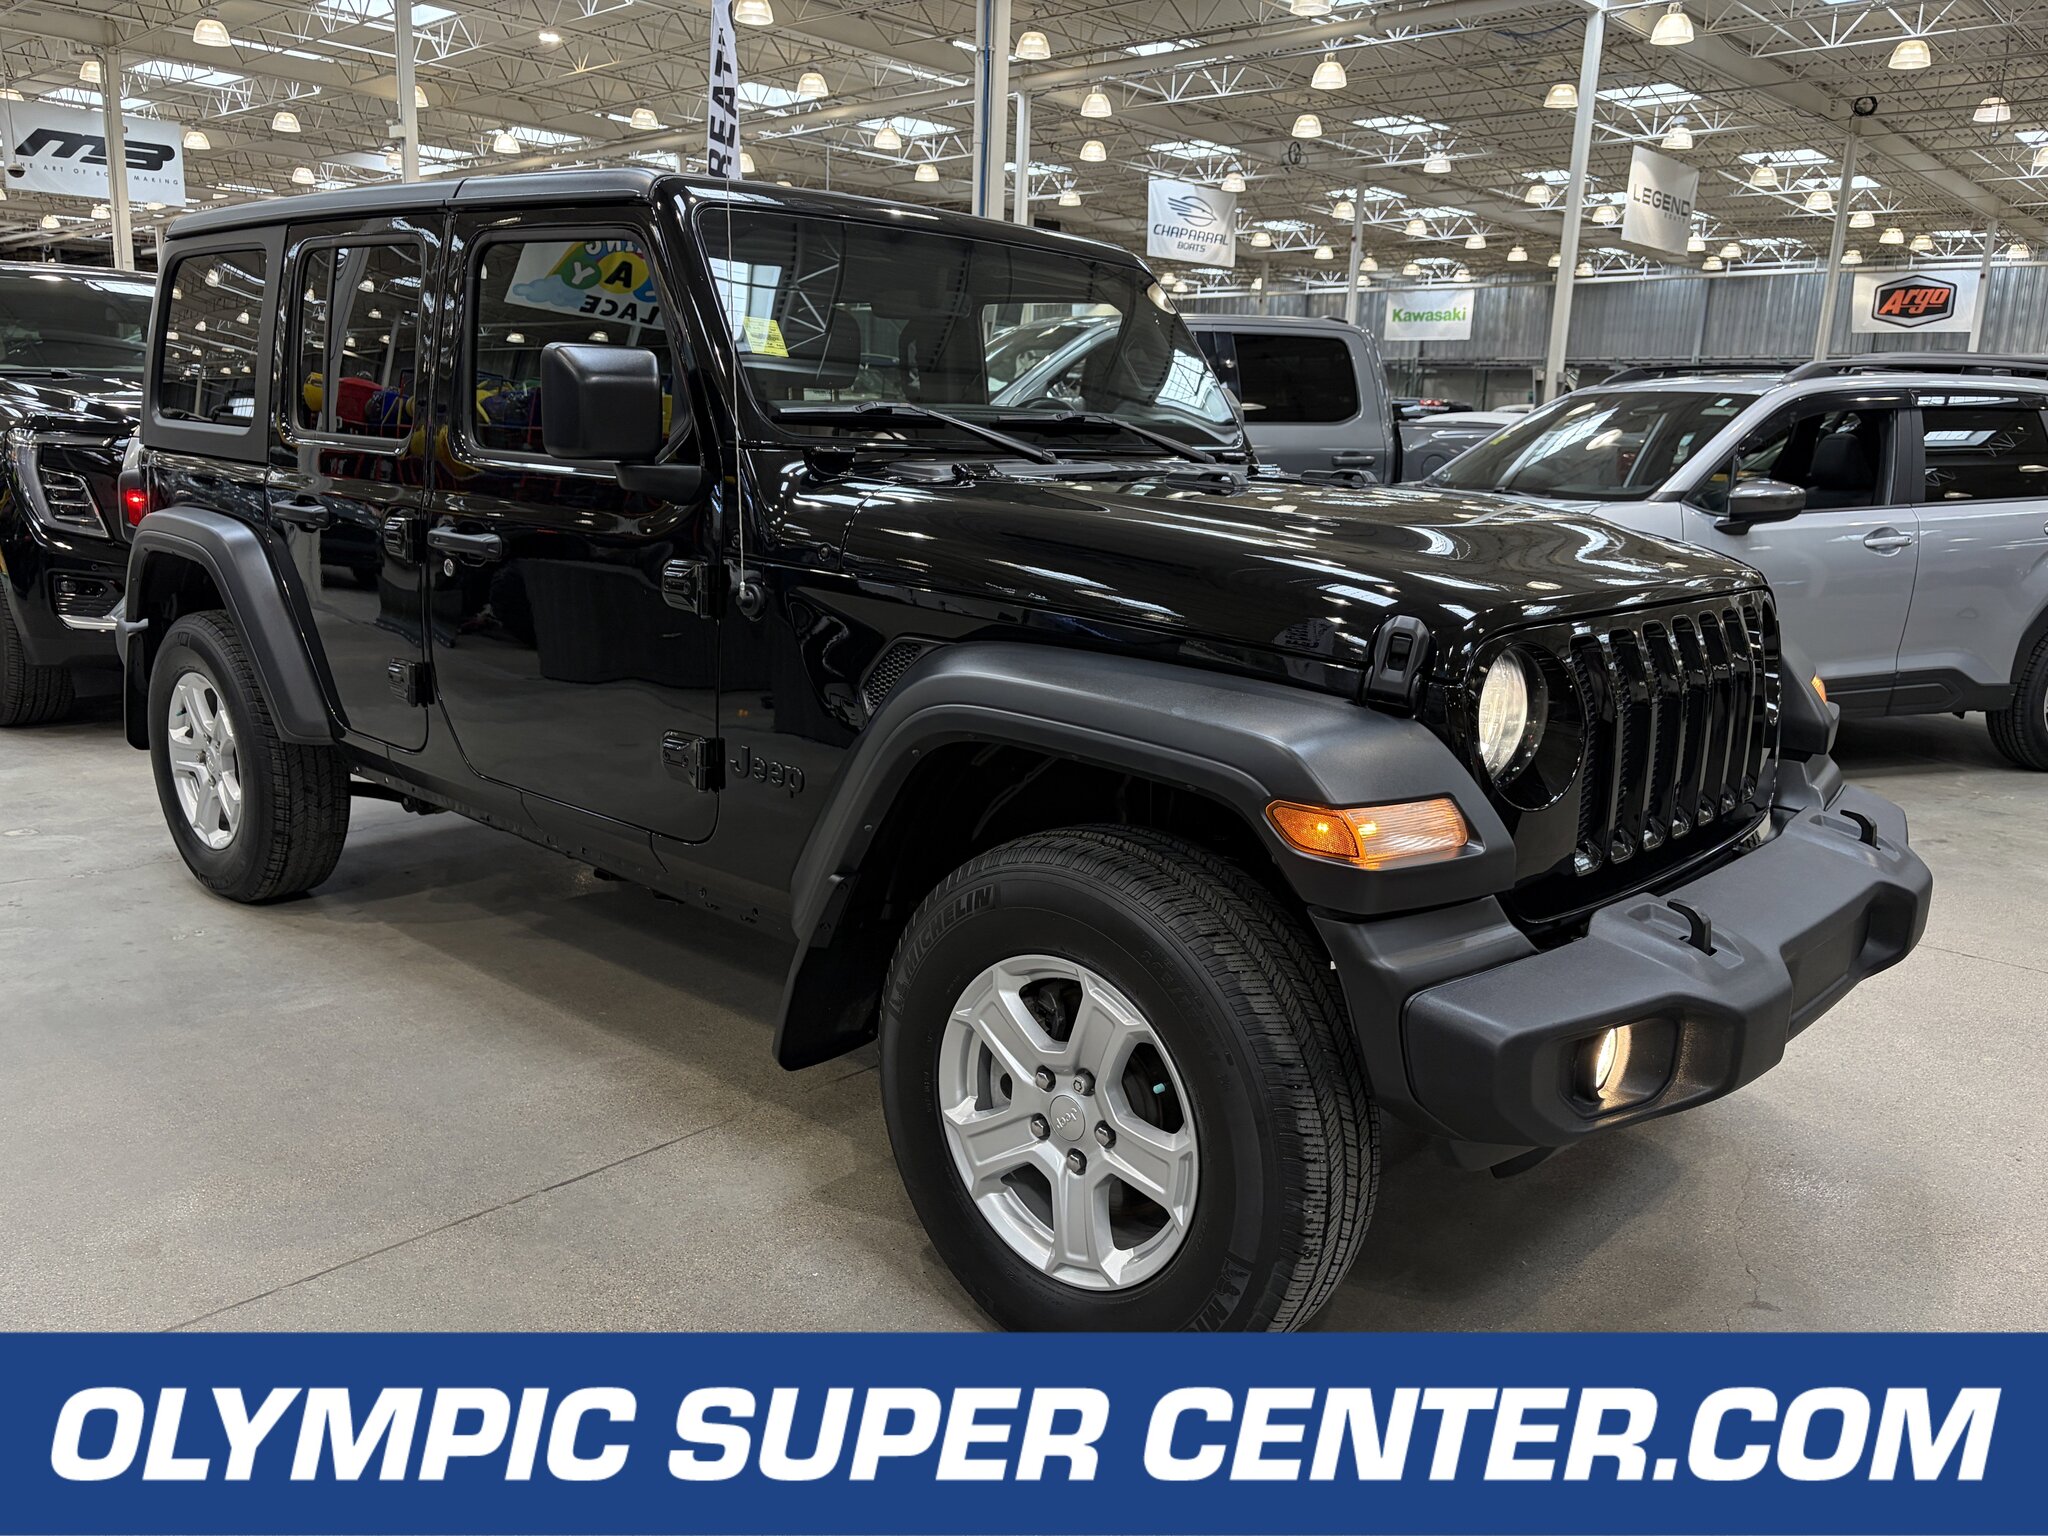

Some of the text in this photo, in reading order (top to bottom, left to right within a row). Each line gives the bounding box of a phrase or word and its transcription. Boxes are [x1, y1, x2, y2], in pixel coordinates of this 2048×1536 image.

[708, 34, 738, 180] REAT
[43, 164, 64, 173] ART
[134, 175, 179, 186] MAKING
[1633, 183, 1691, 217] LEGEND
[1153, 223, 1229, 246] CHAPARRAL
[1177, 240, 1207, 253] BOATS
[1392, 306, 1467, 322] Kawasaki
[1878, 288, 1951, 315] Argo
[730, 745, 805, 798] Jeep
[904, 884, 995, 981] MICHELIN
